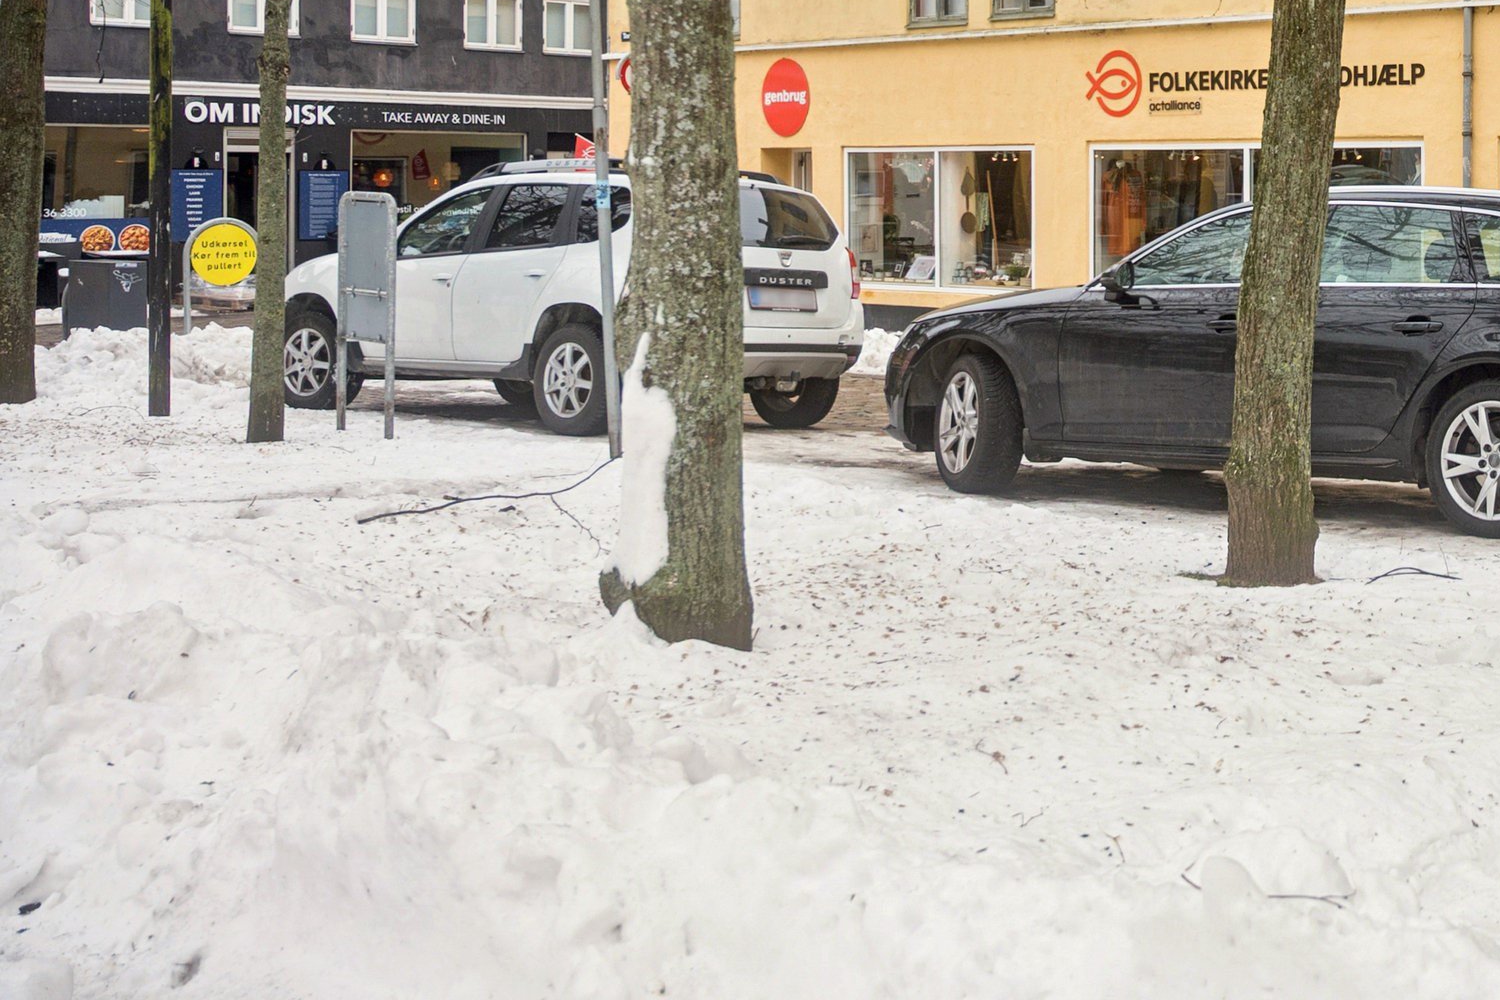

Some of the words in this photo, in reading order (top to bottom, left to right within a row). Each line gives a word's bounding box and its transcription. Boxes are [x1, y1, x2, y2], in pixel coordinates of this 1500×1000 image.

[1149, 69, 1268, 93] FOLKEKIRKE
[1340, 63, 1425, 86] DHJÆLP
[764, 90, 807, 106] genbrug
[1149, 99, 1201, 112] actalliance
[184, 102, 234, 123] OM
[382, 112, 412, 124] TAKE
[414, 112, 451, 124] AWAY
[451, 114, 461, 124] &
[463, 114, 506, 125] DINE-IN
[43, 208, 57, 218] 36
[60, 208, 87, 218] 3300
[201, 240, 248, 249] Udkørsel
[193, 252, 211, 260] Kør
[216, 251, 239, 259] frem
[244, 250, 256, 258] til
[207, 262, 242, 271] pullert
[759, 276, 812, 286] DUSTER
